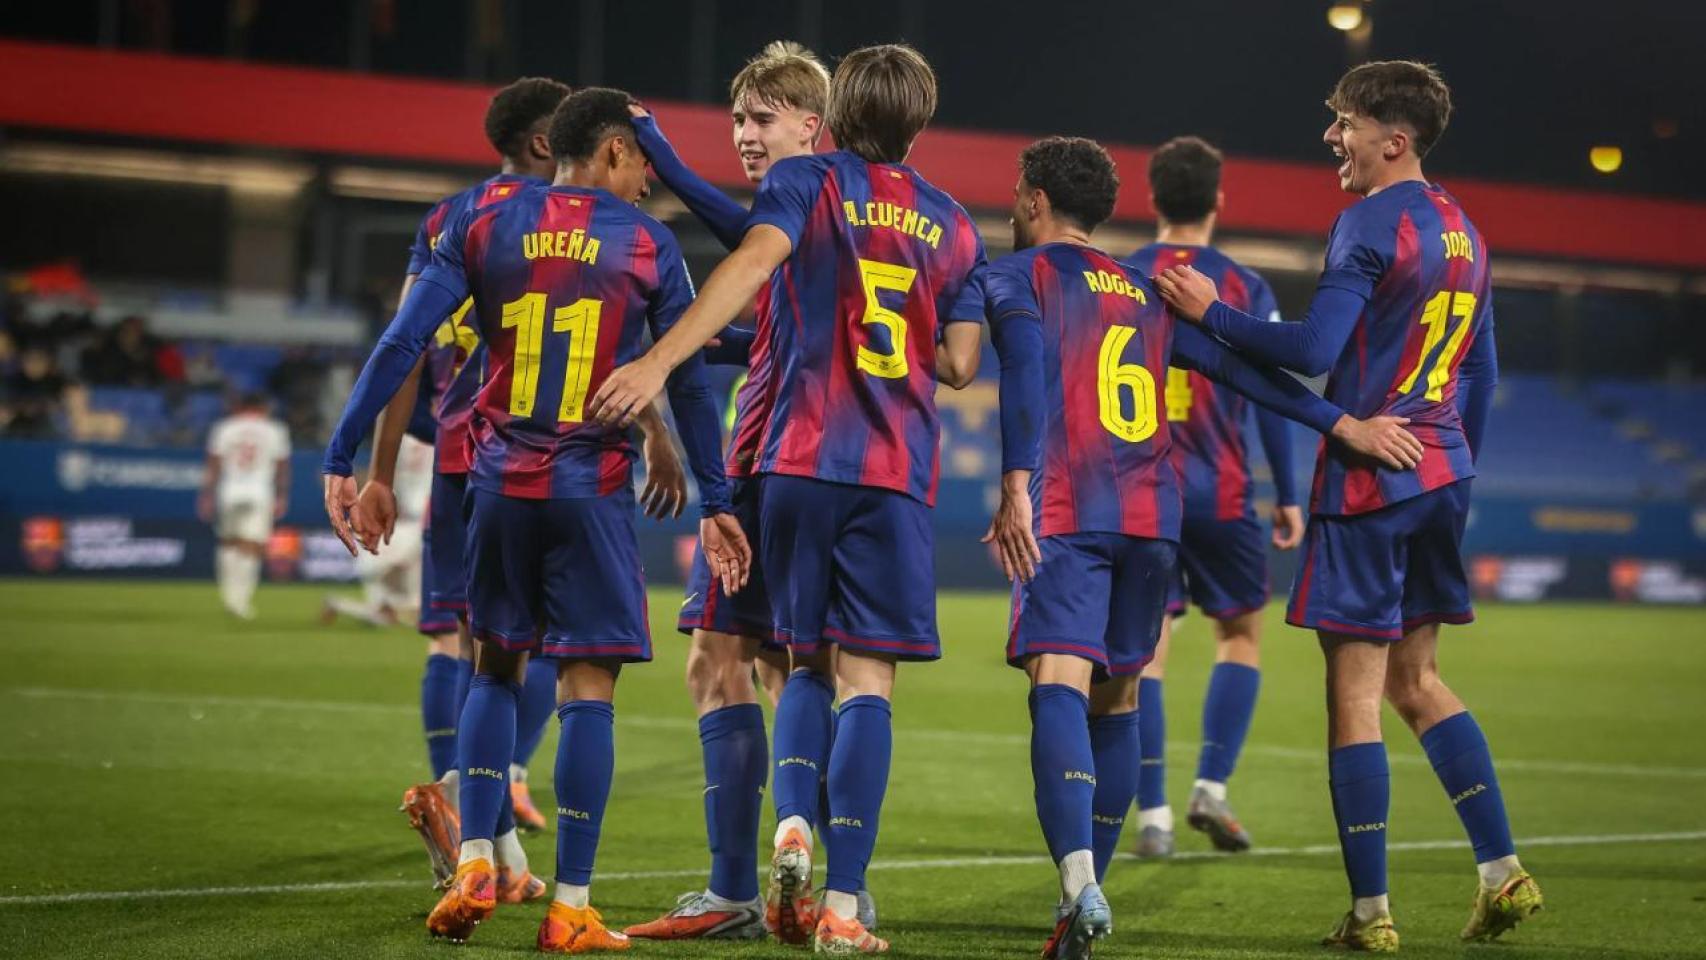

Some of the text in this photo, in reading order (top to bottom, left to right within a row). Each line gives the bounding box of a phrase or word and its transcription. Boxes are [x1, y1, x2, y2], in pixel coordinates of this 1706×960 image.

[522, 229, 601, 265] UREÑA
[843, 200, 943, 250] A.CUENCA
[502, 292, 604, 423] 11
[857, 258, 918, 379] 5
[1397, 290, 1477, 403] 17
[1098, 324, 1160, 443] 6
